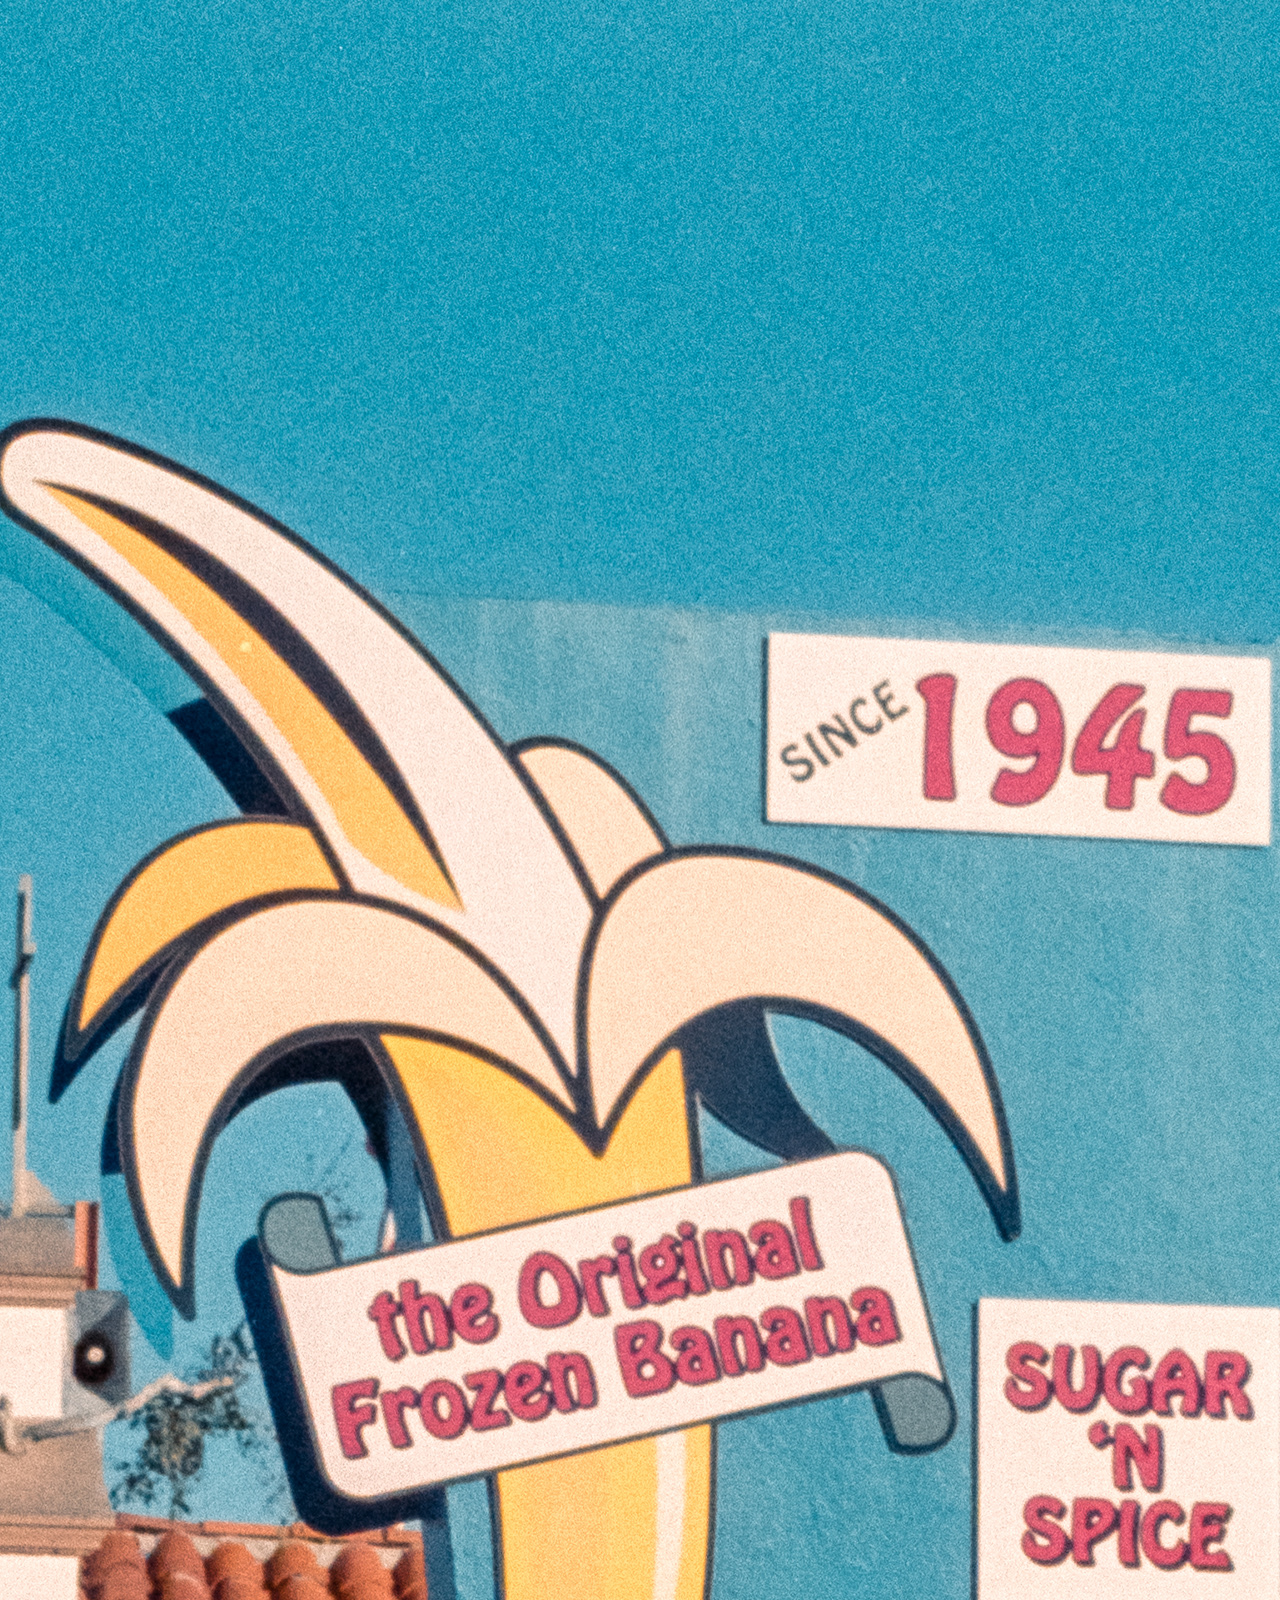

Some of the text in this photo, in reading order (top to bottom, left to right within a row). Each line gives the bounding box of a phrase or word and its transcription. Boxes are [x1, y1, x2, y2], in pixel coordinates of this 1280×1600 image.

[780, 672, 1237, 816] SINCE 1945
[367, 1196, 824, 1362] the Original
[332, 1286, 902, 1460] Frozen Banana
[1004, 1340, 1254, 1421] SUGAR
[1021, 1494, 1234, 1573] SPICE
